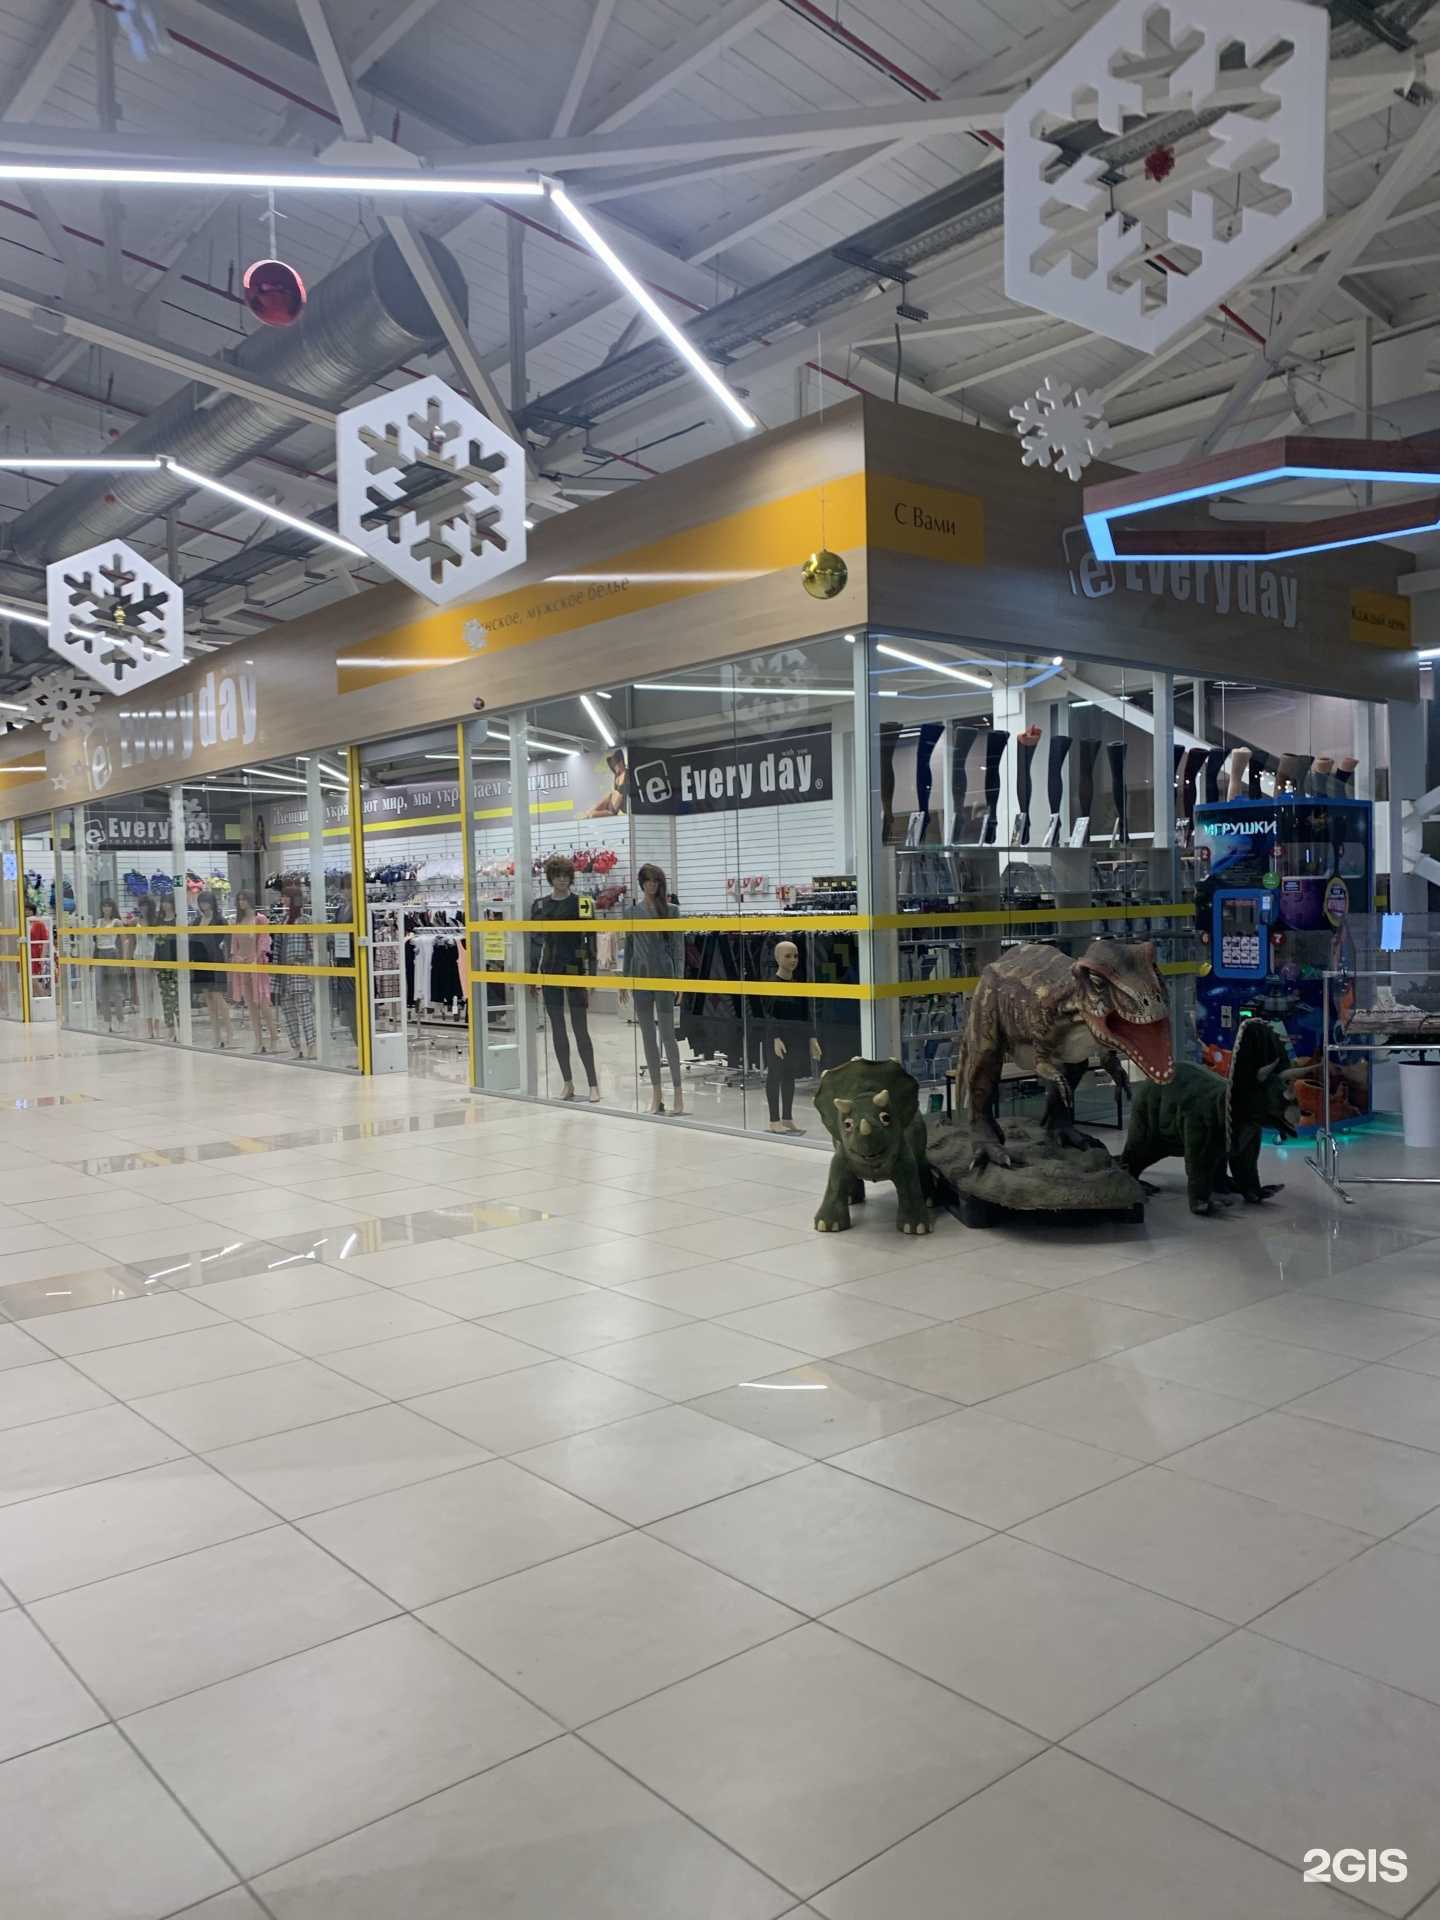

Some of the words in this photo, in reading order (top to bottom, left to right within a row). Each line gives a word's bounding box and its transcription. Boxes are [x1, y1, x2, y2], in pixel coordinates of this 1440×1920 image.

[894, 502, 907, 525] С
[913, 506, 956, 536] Вами
[680, 765, 753, 802] Every
[759, 753, 812, 793] day
[383, 796, 407, 815] мир,
[413, 792, 432, 807] мы
[108, 817, 168, 840] Every
[1274, 933, 1282, 944] 7
